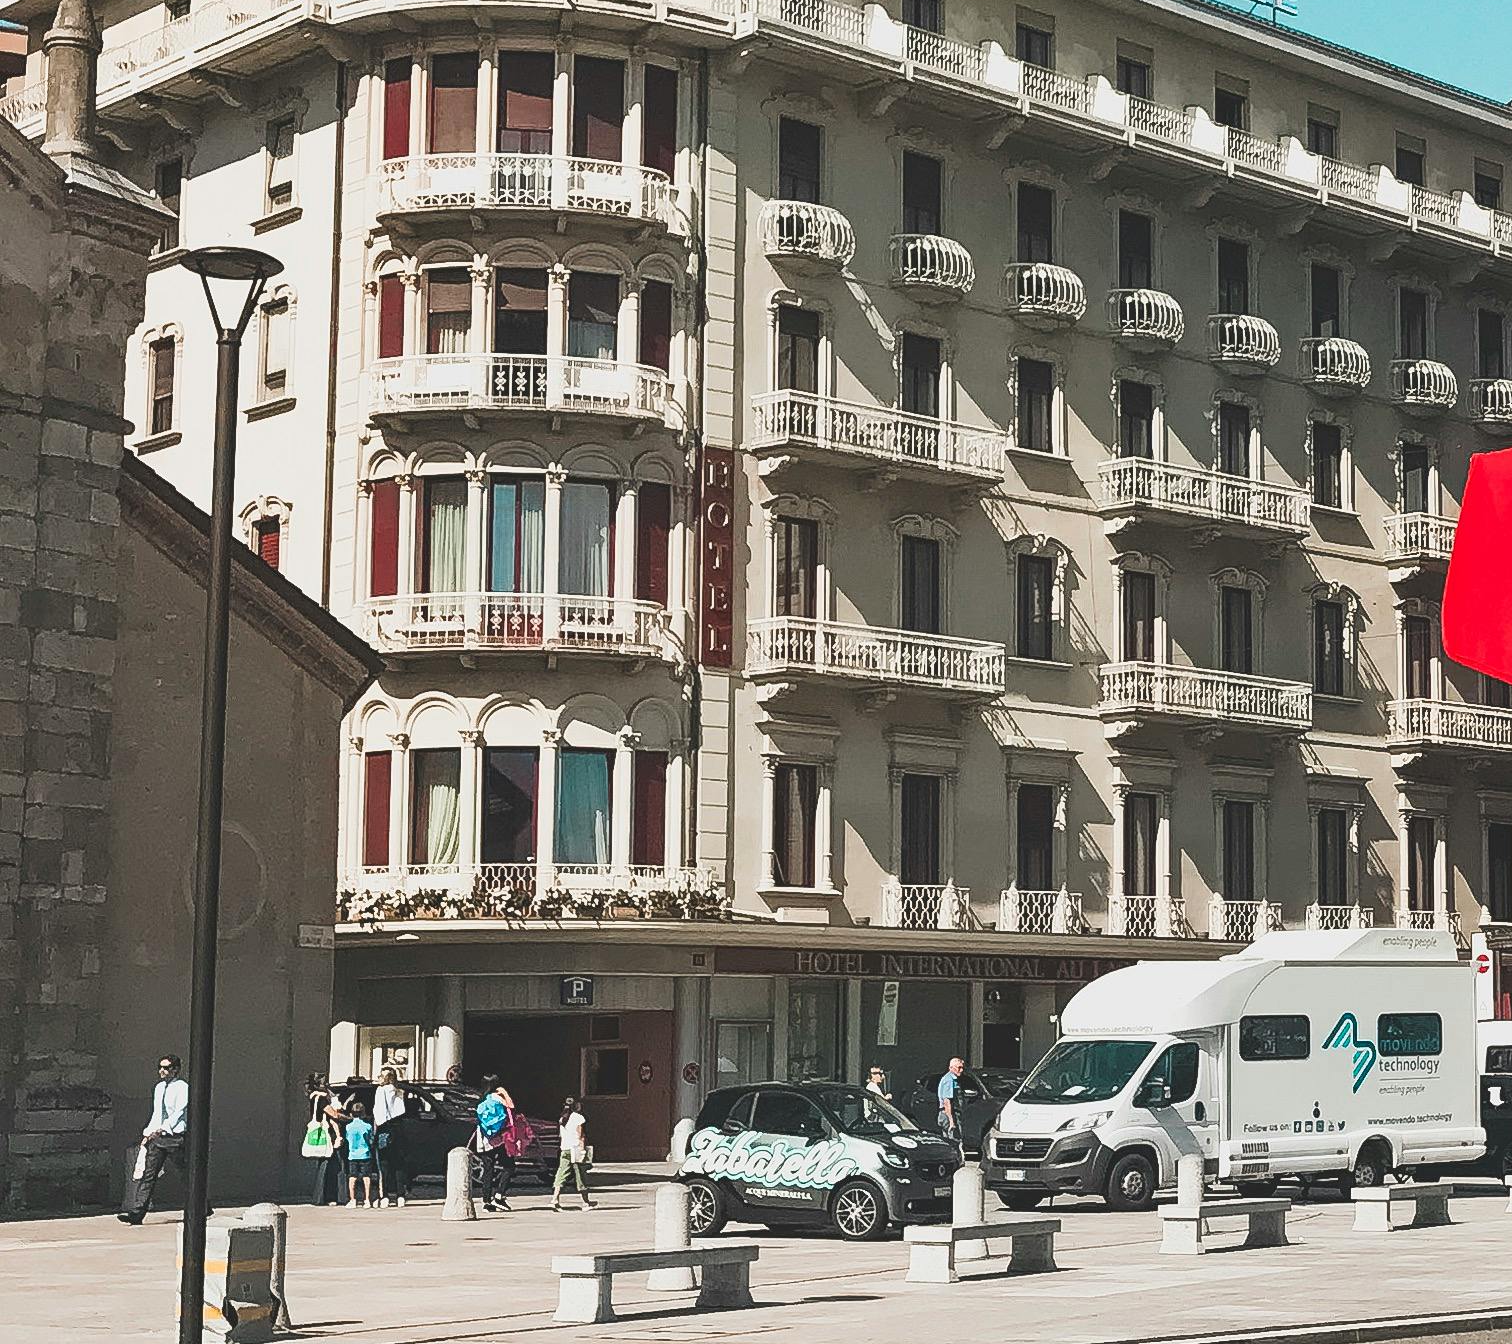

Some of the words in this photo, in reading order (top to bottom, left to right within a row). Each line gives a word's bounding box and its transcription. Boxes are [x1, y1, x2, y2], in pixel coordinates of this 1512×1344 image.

[706, 459, 731, 652] HOTEL
[795, 951, 869, 974] HOTEL
[881, 954, 1044, 978] INTERNATIONAL
[1379, 1055, 1440, 1075] technology
[1243, 1122, 1268, 1133] Follow
